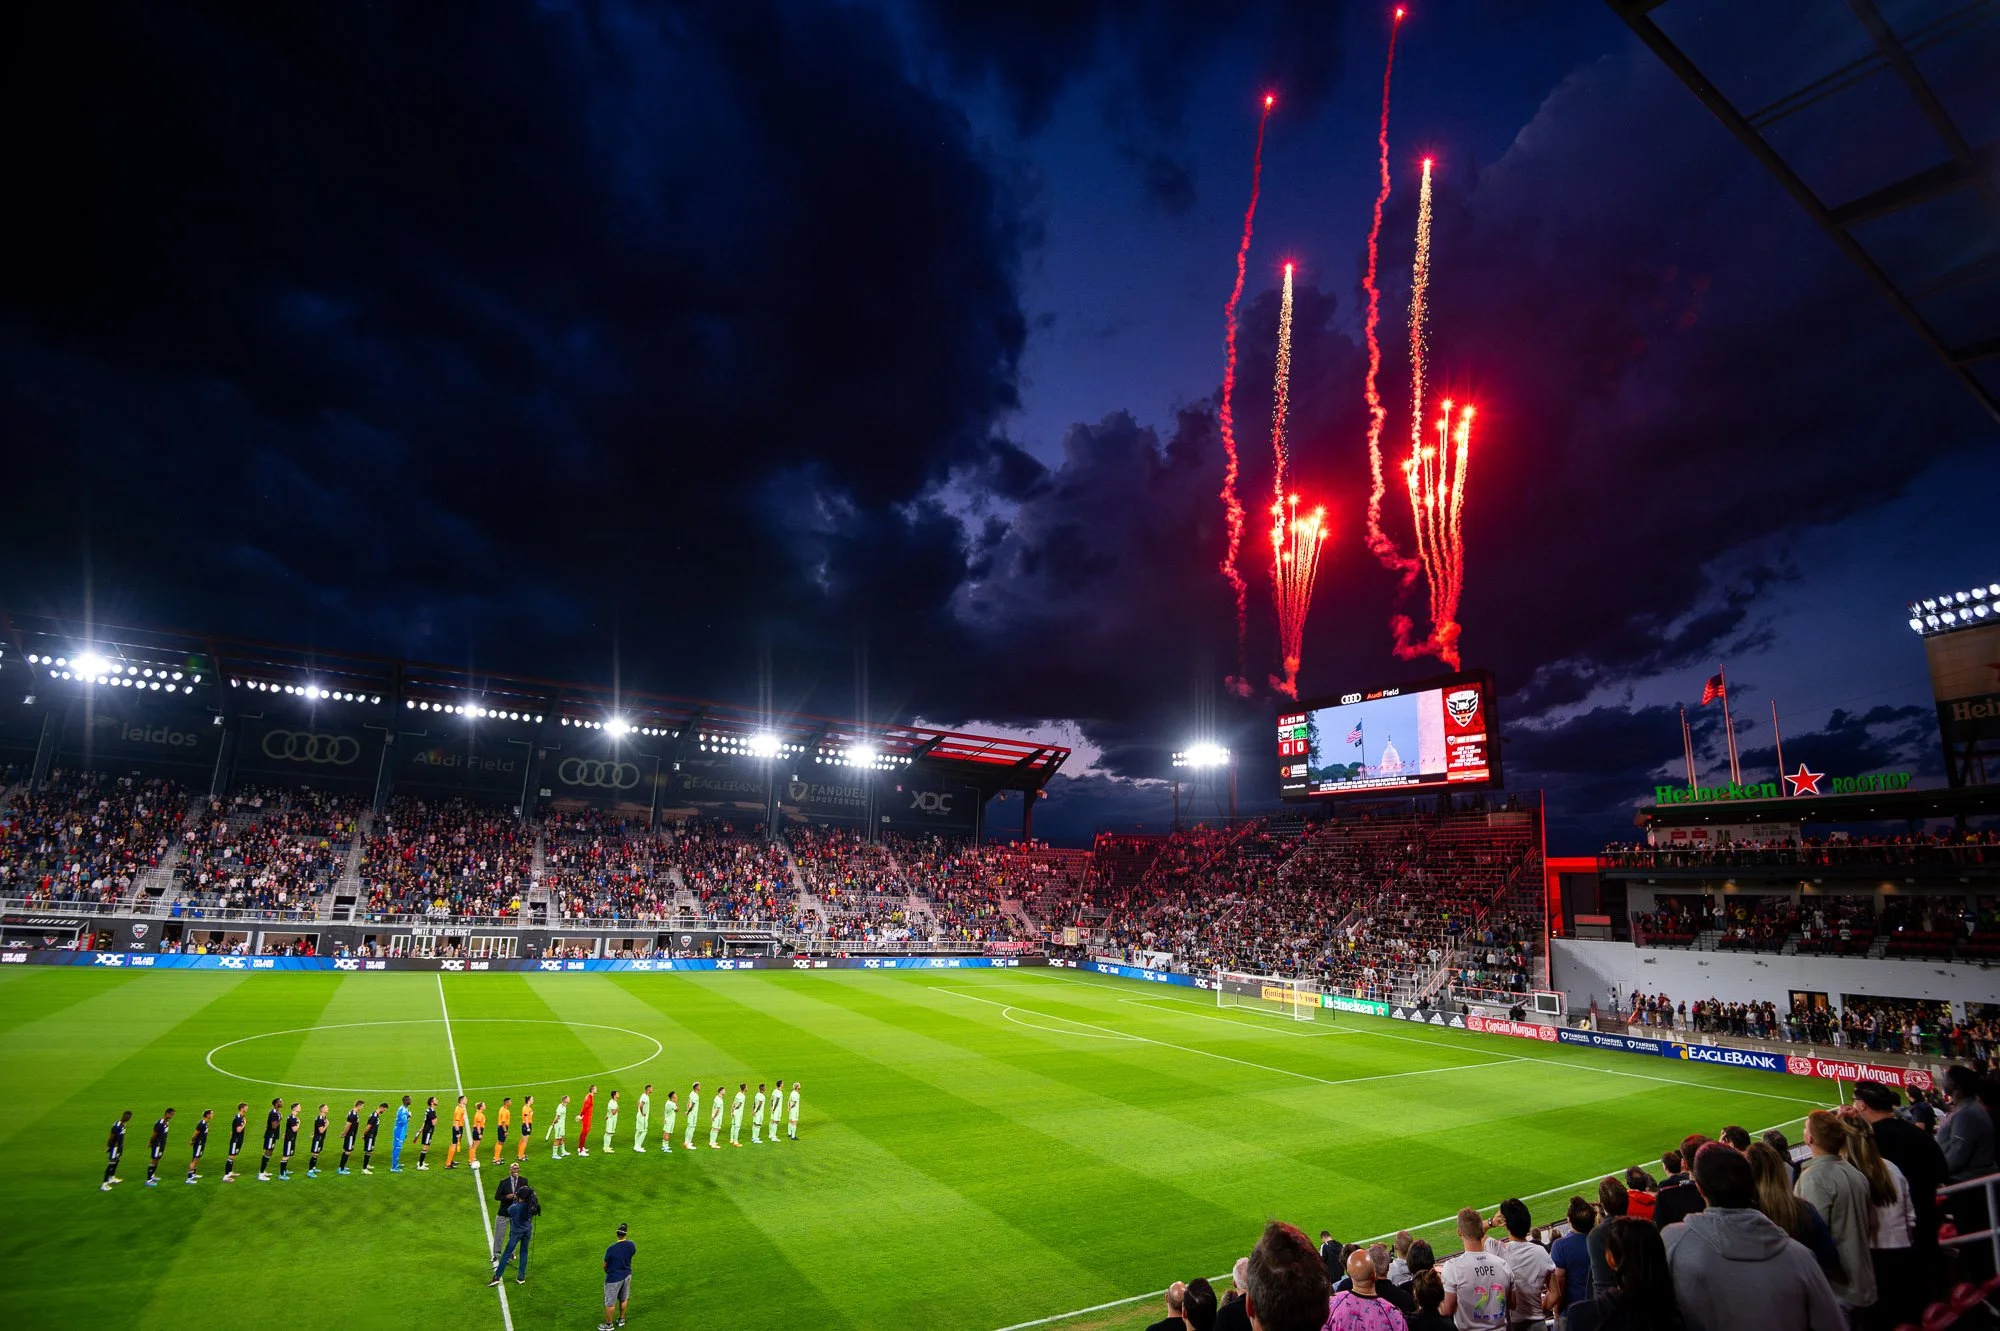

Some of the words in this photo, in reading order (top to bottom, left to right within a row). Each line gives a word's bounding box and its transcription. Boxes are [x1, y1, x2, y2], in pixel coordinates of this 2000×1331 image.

[1366, 691, 1382, 700] Audi
[1382, 688, 1399, 697] Field
[1951, 697, 2000, 721] Hei
[121, 721, 197, 747] leidos
[1283, 743, 1290, 754] 0
[1297, 741, 1304, 752] 0
[413, 750, 462, 768] Audi
[467, 756, 515, 773] Field
[810, 783, 866, 798] FANDUEL
[1654, 780, 1779, 804] Heineken
[1831, 772, 1912, 793] ROOFTOP
[810, 795, 867, 807] SPORTSBOOK
[910, 790, 953, 812] XDC
[432, 928, 444, 936] THE
[444, 929, 472, 937] DISTRICT
[95, 953, 125, 965] XDC
[219, 956, 246, 967] XDC
[334, 959, 360, 969] XDC
[441, 960, 465, 970] XDC
[540, 960, 563, 970] XDC
[1305, 996, 1319, 1005] TIRE
[1324, 994, 1375, 1015] Heineken
[1485, 1019, 1511, 1034] Captain
[1509, 1020, 1537, 1039] Morgan
[1602, 1037, 1623, 1045] FANDUEL
[1636, 1041, 1658, 1049] FANDUEL
[1688, 1046, 1777, 1069] EAGLEBANK
[1816, 1060, 1857, 1079] Captain
[1854, 1065, 1901, 1086] Morgan
[1474, 1266, 1495, 1277] POPE
[1473, 1283, 1505, 1320] 23
